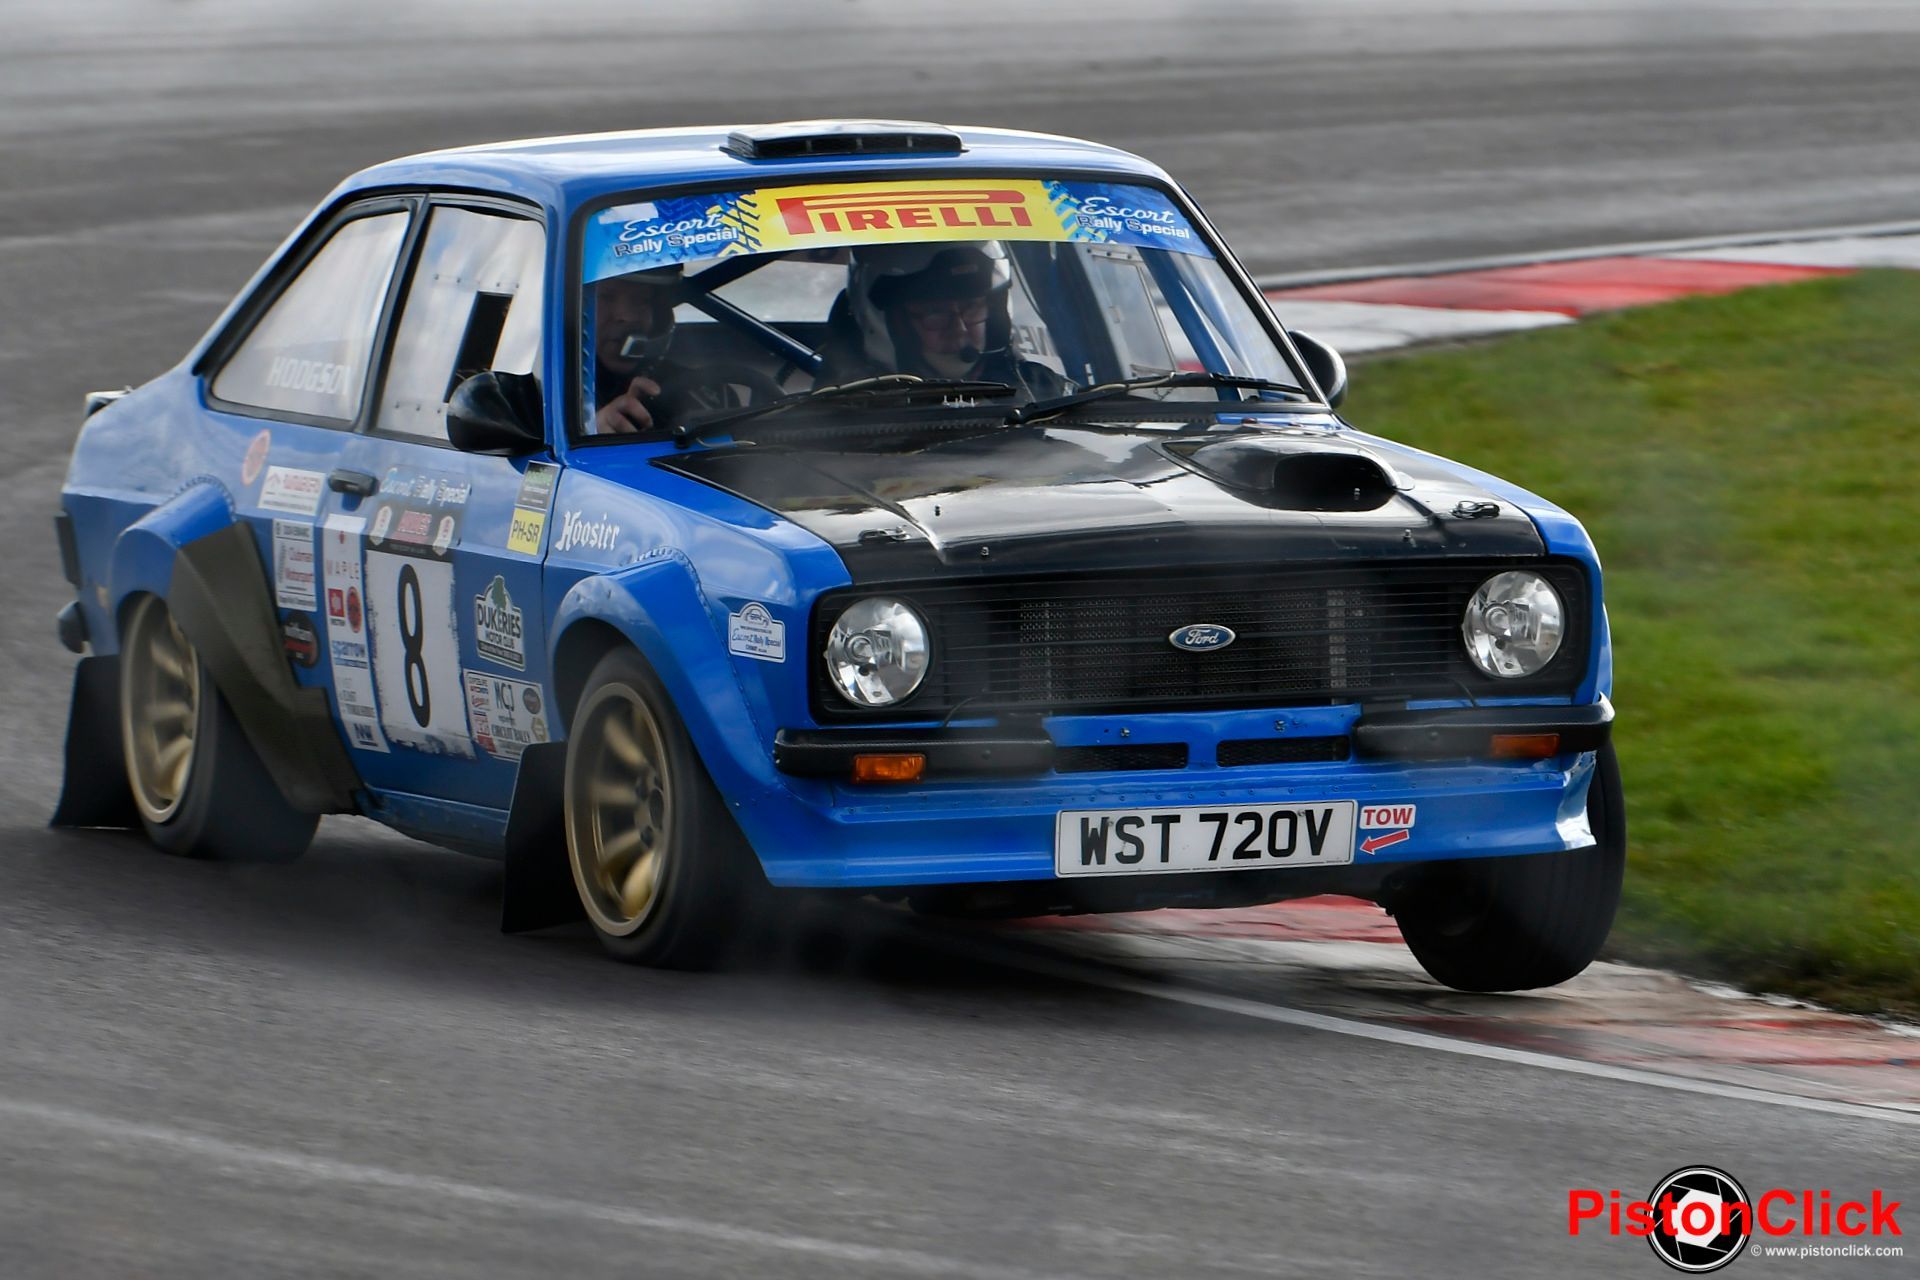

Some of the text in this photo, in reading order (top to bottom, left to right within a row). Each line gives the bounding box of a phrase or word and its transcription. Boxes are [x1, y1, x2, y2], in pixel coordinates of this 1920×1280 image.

[775, 189, 1033, 235] PIRELLI
[1075, 196, 1176, 224] Escort
[613, 226, 738, 257] Rally Special
[618, 213, 723, 241] Escort
[1076, 214, 1190, 240] Rally Special
[511, 519, 541, 543] PH-SR
[555, 509, 620, 551] Hoosier
[477, 603, 521, 639] DUKERIES
[397, 563, 432, 729] 8
[1184, 629, 1220, 645] Ford
[1363, 808, 1414, 826] TOW
[1080, 808, 1334, 866] WST 720V
